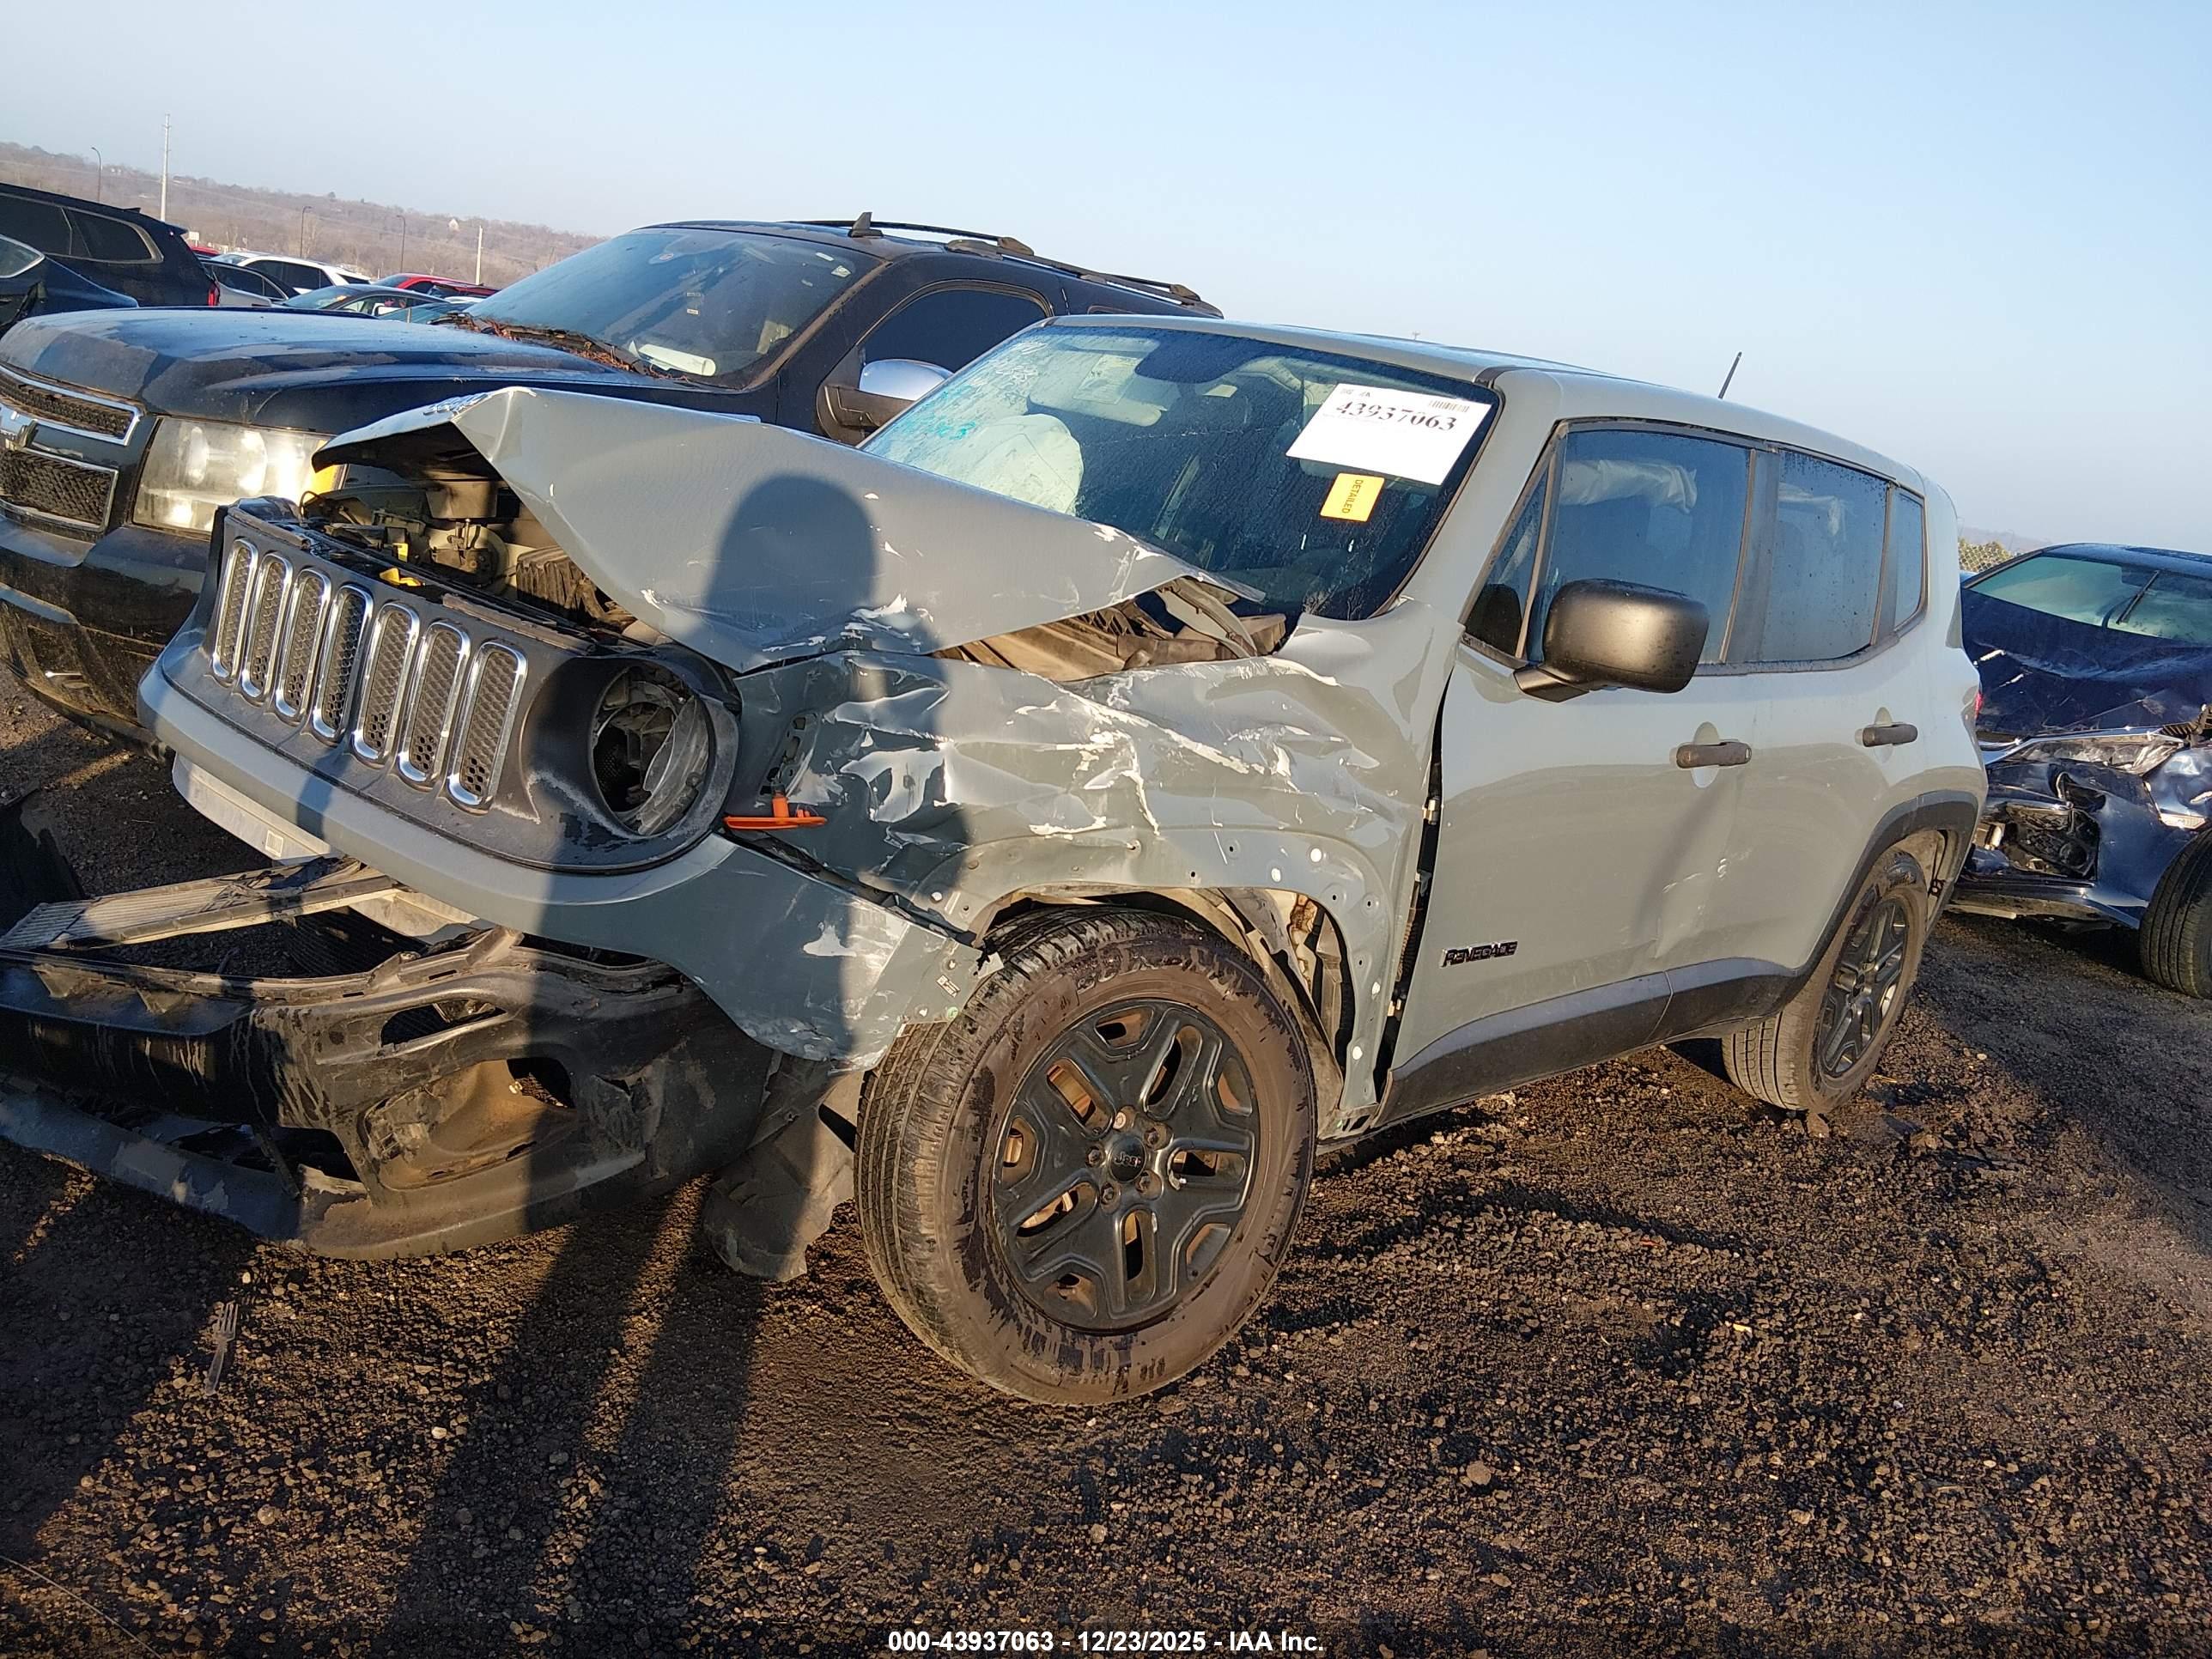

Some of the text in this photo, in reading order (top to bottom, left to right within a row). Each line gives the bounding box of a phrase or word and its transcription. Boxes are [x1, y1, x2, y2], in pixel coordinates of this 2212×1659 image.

[1336, 401, 1457, 431] 43937063
[1341, 479, 1364, 514] DETAILED
[1441, 941, 1518, 968] RENEGADE
